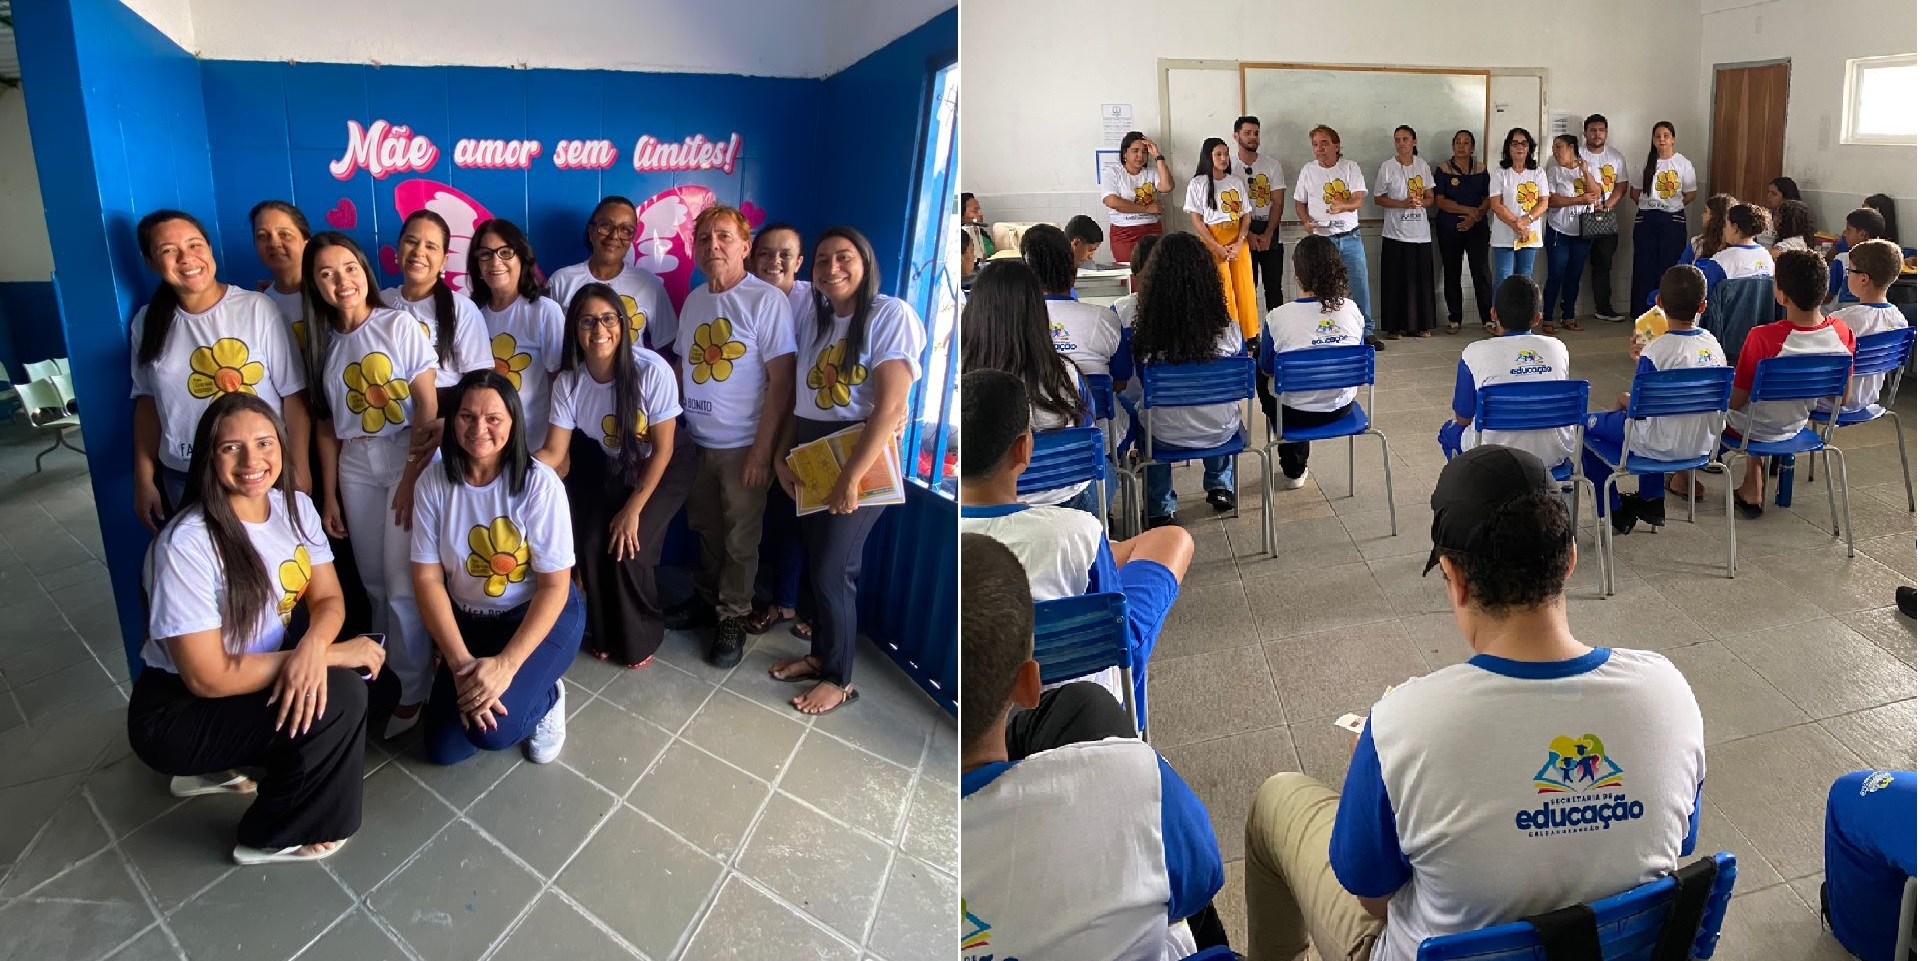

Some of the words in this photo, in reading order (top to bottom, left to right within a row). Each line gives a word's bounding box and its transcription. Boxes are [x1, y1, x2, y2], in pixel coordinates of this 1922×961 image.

[329, 119, 440, 181] Mãe
[454, 137, 542, 169] amor
[553, 137, 619, 169] sem
[632, 131, 741, 175] limites!
[688, 398, 712, 412] BONITO
[180, 443, 194, 457] FA
[1551, 794, 1600, 805] SECRETARIA
[1515, 794, 1644, 830] educação
